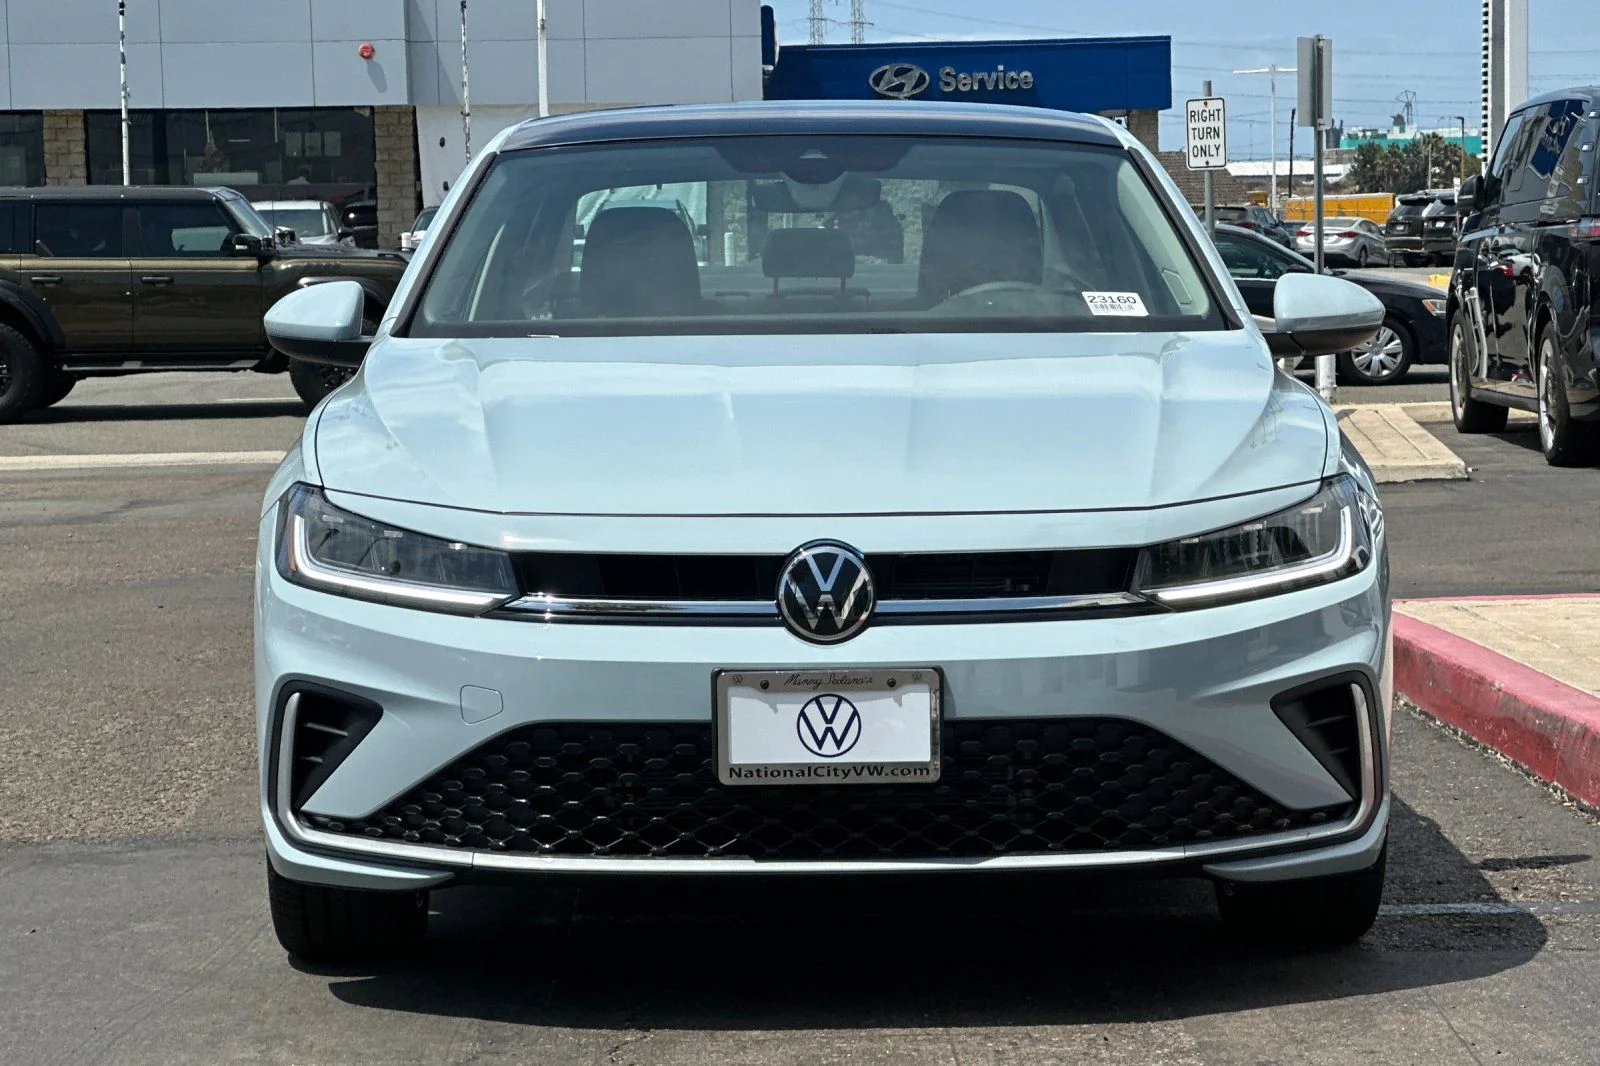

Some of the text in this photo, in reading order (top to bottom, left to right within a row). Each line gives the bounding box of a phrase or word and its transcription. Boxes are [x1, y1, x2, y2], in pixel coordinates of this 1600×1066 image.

[939, 64, 1034, 92] Service
[1189, 108, 1222, 123] RIGHT
[1191, 126, 1220, 140] TURN
[1192, 144, 1221, 158] ONLY
[1086, 295, 1137, 304] 23160
[782, 547, 872, 637] VW
[784, 673, 824, 691] Manny
[799, 695, 860, 755] VW
[729, 765, 931, 779] NationalCityVW.com
